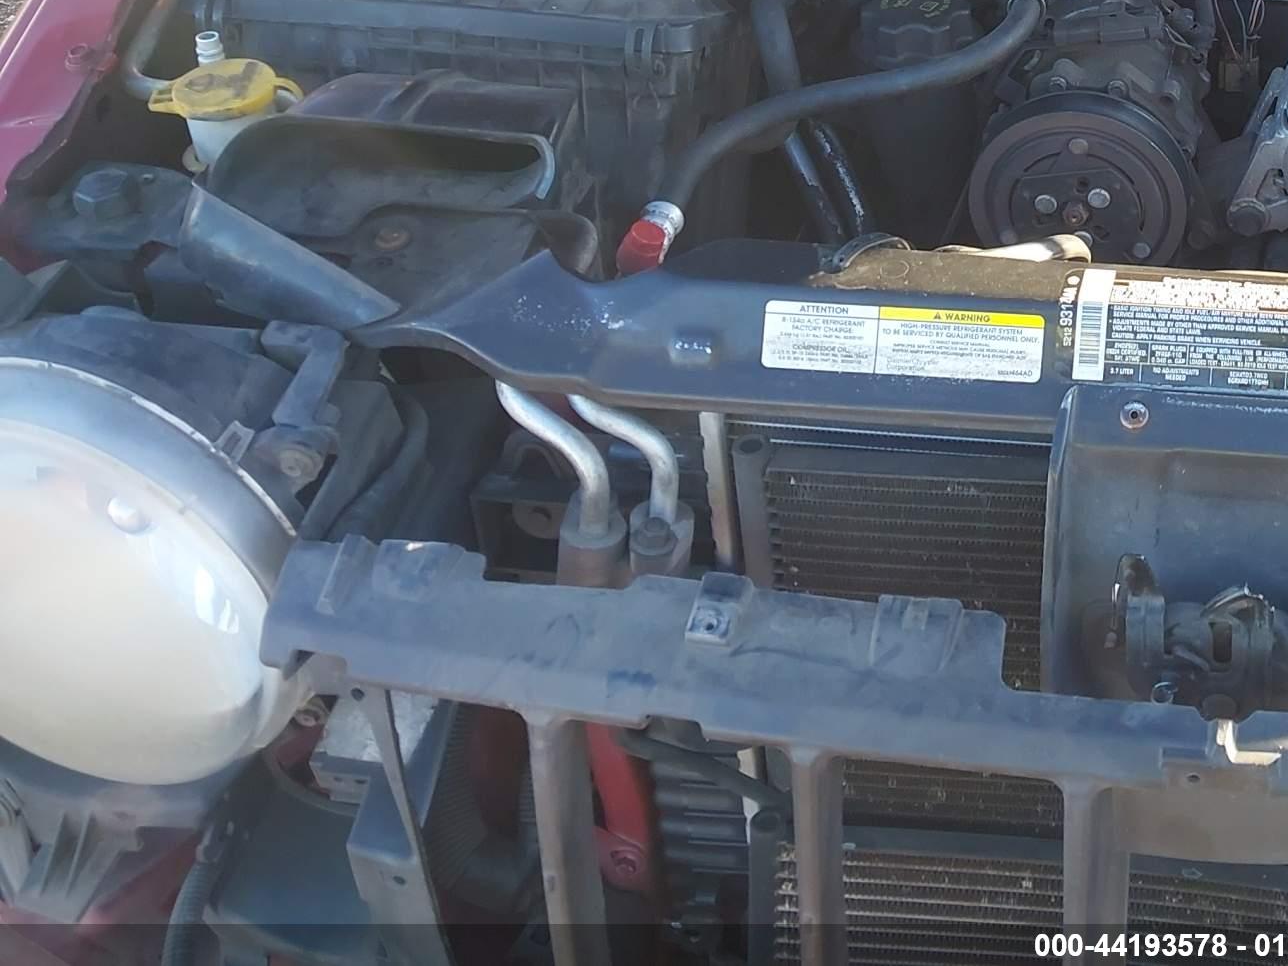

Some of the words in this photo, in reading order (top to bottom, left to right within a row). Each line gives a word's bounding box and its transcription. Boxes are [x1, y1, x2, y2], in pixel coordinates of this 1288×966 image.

[800, 305, 848, 314] ATTENTION
[946, 313, 990, 322] WARNING
[822, 319, 865, 328] REFRIGERANT
[901, 323, 951, 332] HIGH-PRESSURE
[954, 326, 996, 334] REFRIGERANT
[903, 330, 934, 338] SERVICED
[982, 334, 1018, 342] PERSONNEL
